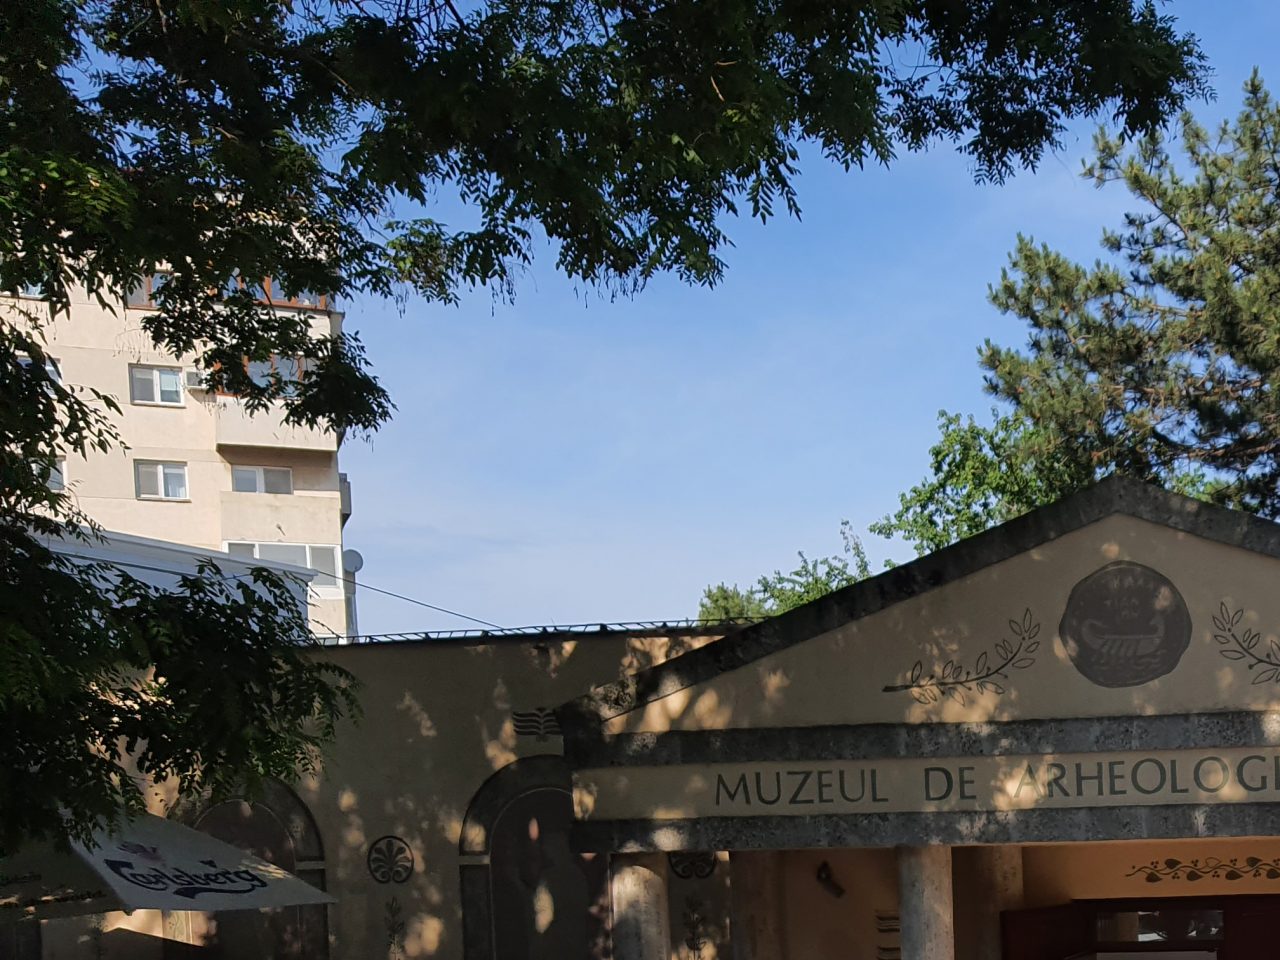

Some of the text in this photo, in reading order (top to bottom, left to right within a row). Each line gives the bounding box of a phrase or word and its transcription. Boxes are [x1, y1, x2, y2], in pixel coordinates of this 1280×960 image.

[714, 768, 889, 807] MUZEUL
[923, 766, 978, 802] DE
[104, 859, 268, 899] Carlsberg
